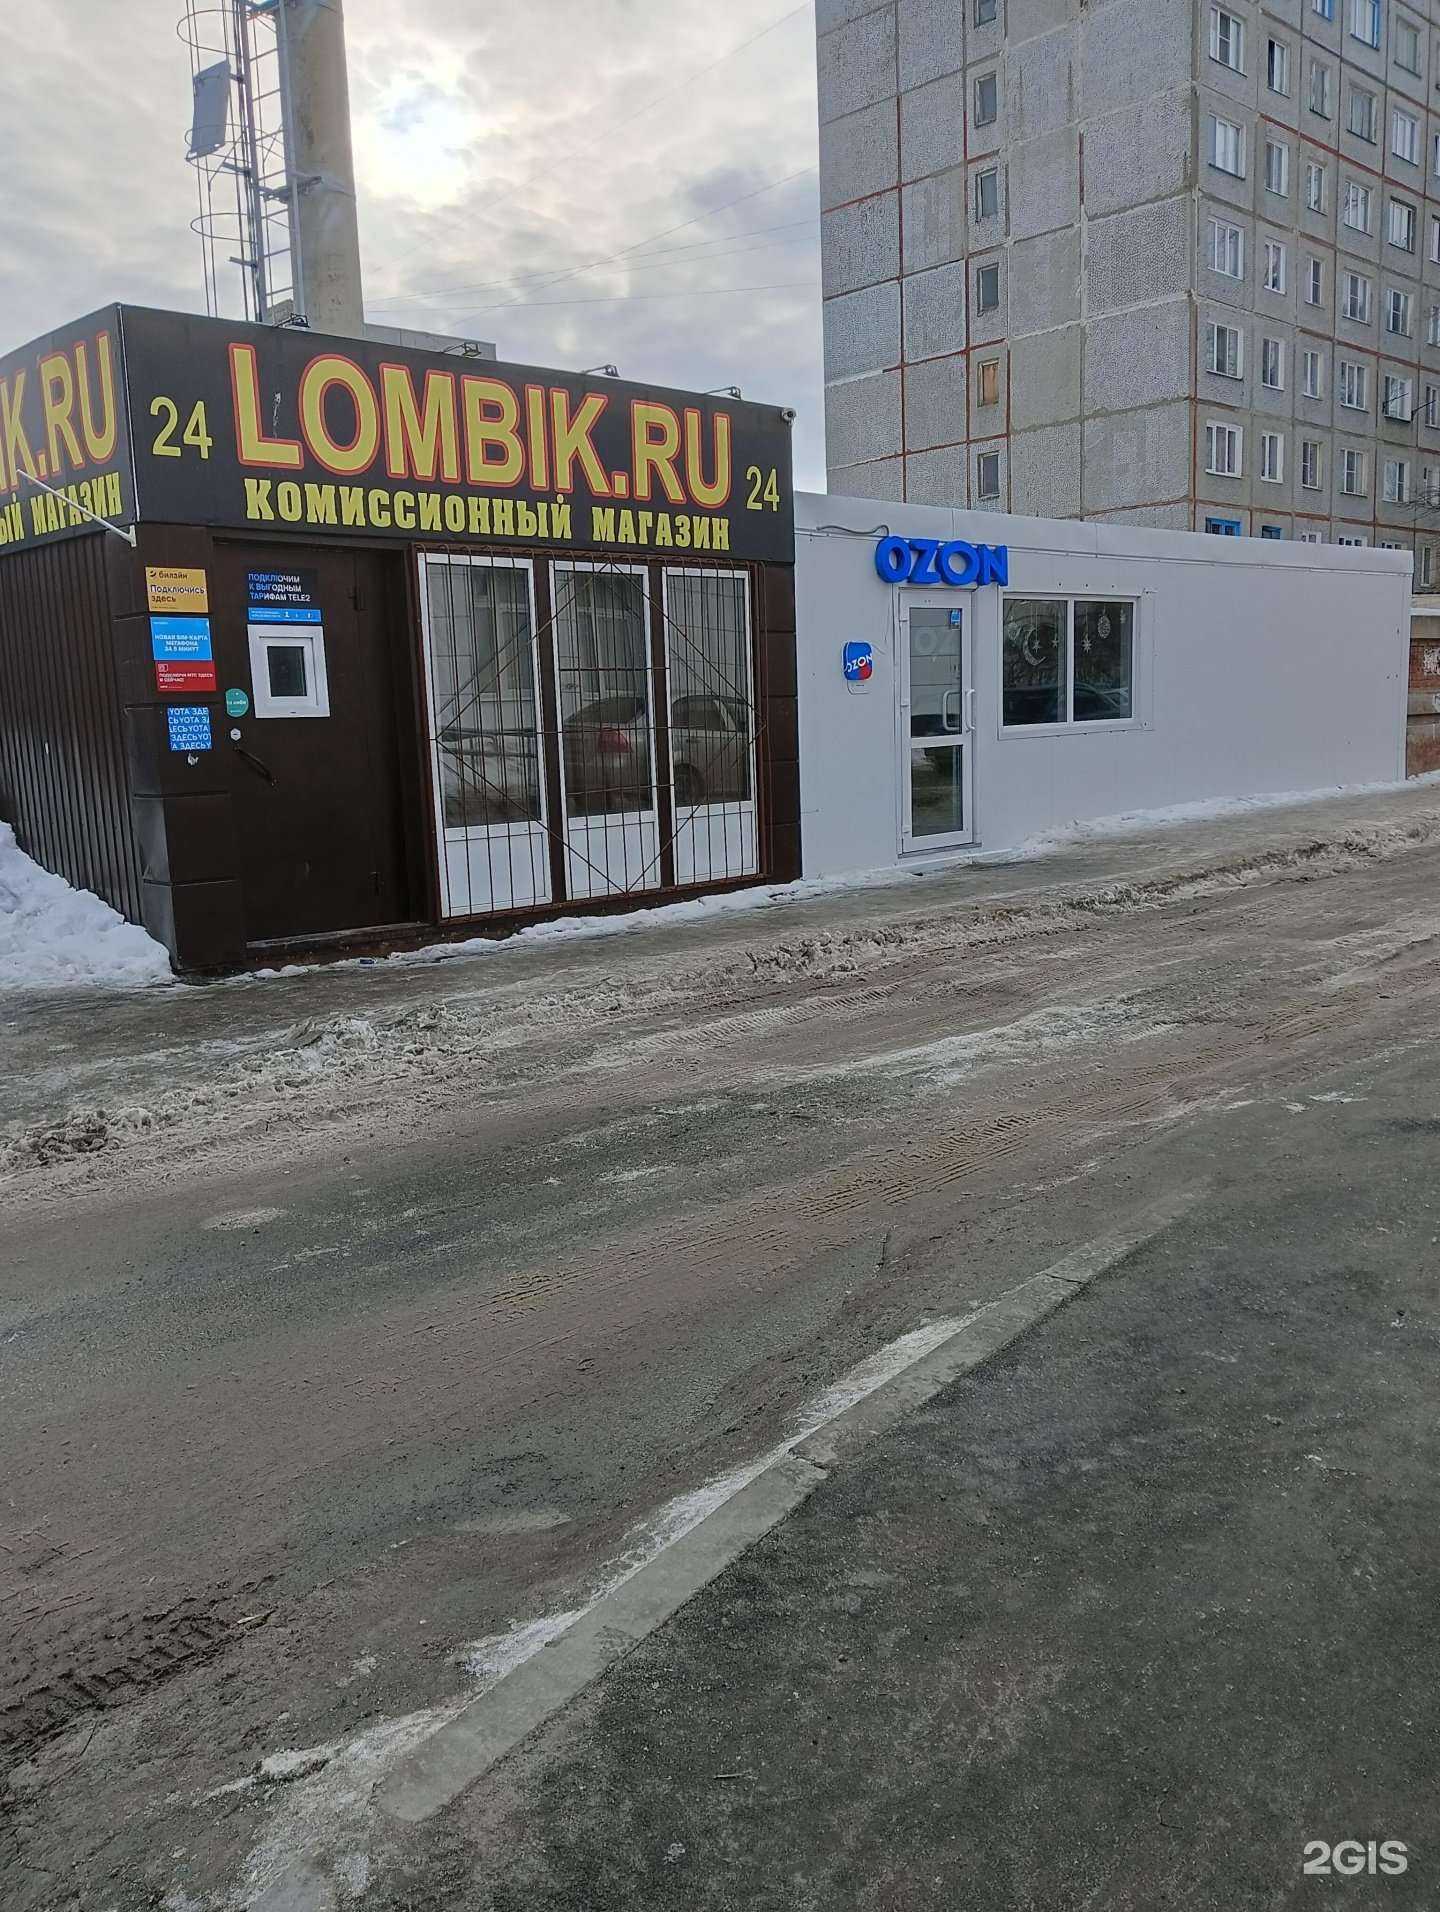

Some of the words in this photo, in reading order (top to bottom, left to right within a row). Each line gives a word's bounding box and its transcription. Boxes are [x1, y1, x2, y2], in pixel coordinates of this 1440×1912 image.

[150, 396, 213, 459] 24
[228, 343, 733, 509] LOMBIK.RU
[31, 472, 123, 536] МАГАЗИН
[745, 465, 780, 512] 24
[244, 478, 572, 540] КОМИССИОННЫЙ
[592, 506, 730, 551] МАГАЗИН
[248, 573, 300, 583] ПОДКЛЮЧИМ
[875, 536, 1008, 586] OZON
[150, 585, 205, 594] Подключись
[250, 592, 287, 601] ТАРИФАМ
[256, 583, 302, 593] ВЫГОДНЫМ
[843, 653, 873, 673] OZON
